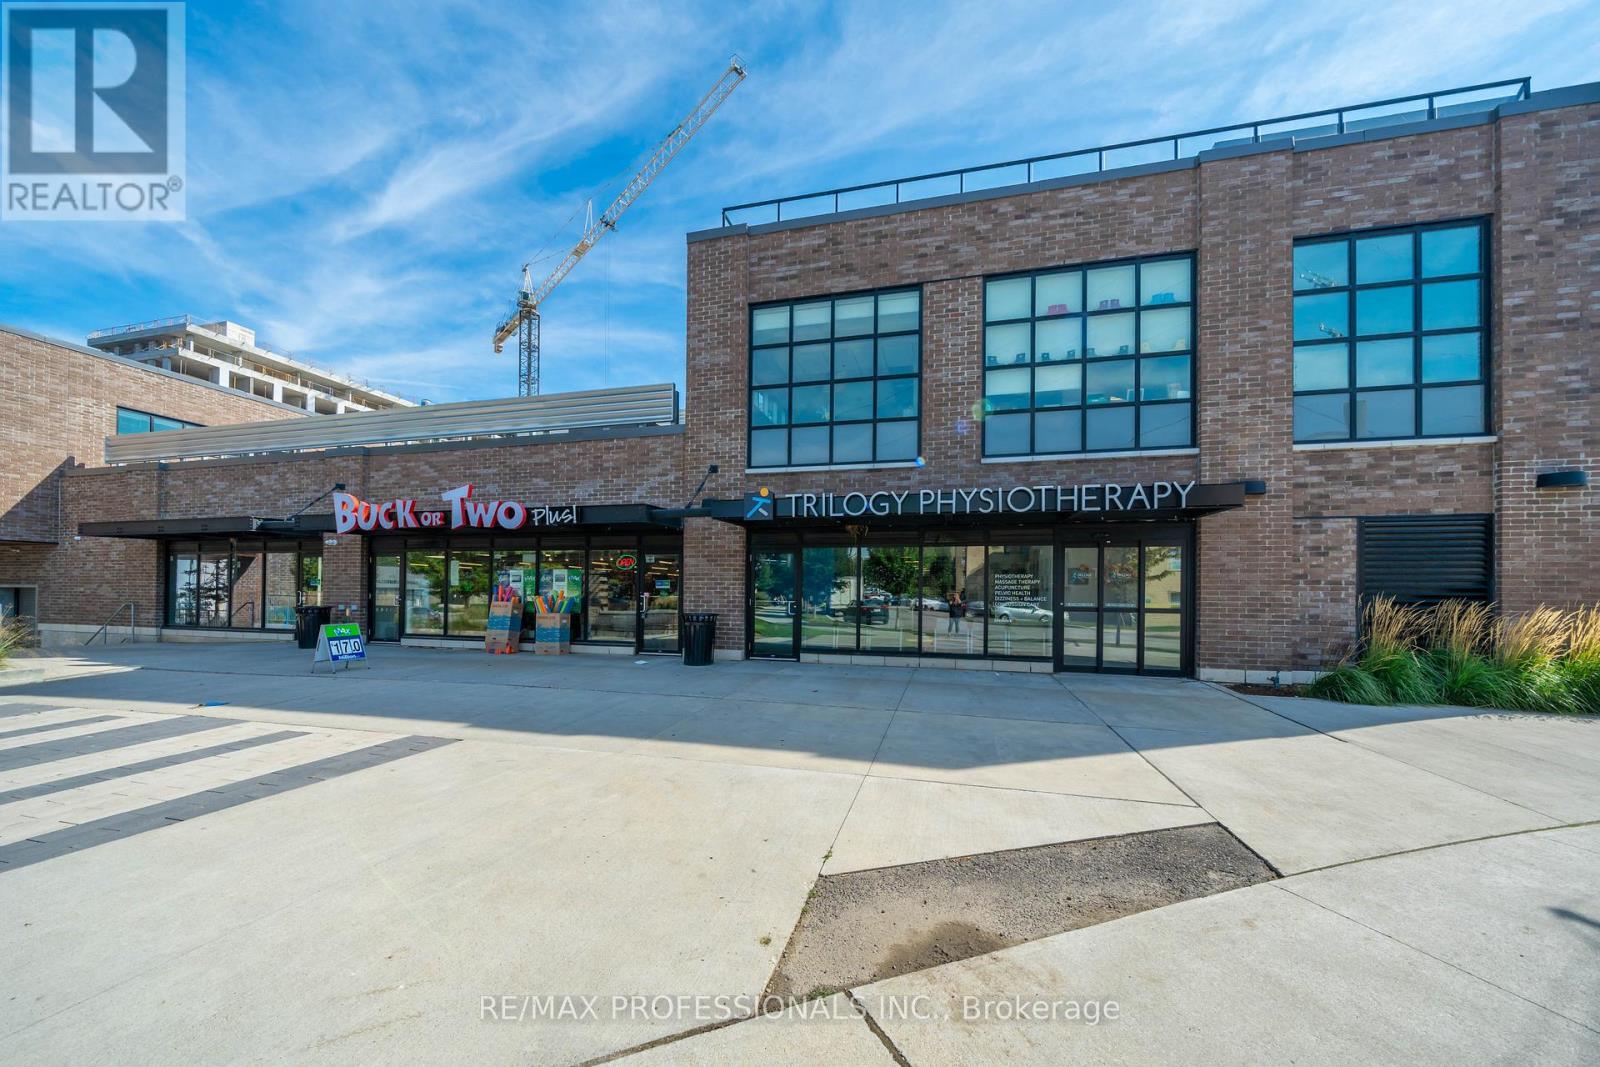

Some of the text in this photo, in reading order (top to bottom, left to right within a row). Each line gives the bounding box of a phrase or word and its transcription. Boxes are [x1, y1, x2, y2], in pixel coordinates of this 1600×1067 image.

[785, 480, 1196, 518] TRILOGY PHYSIOTHERAPY
[618, 557, 635, 567] OPEN
